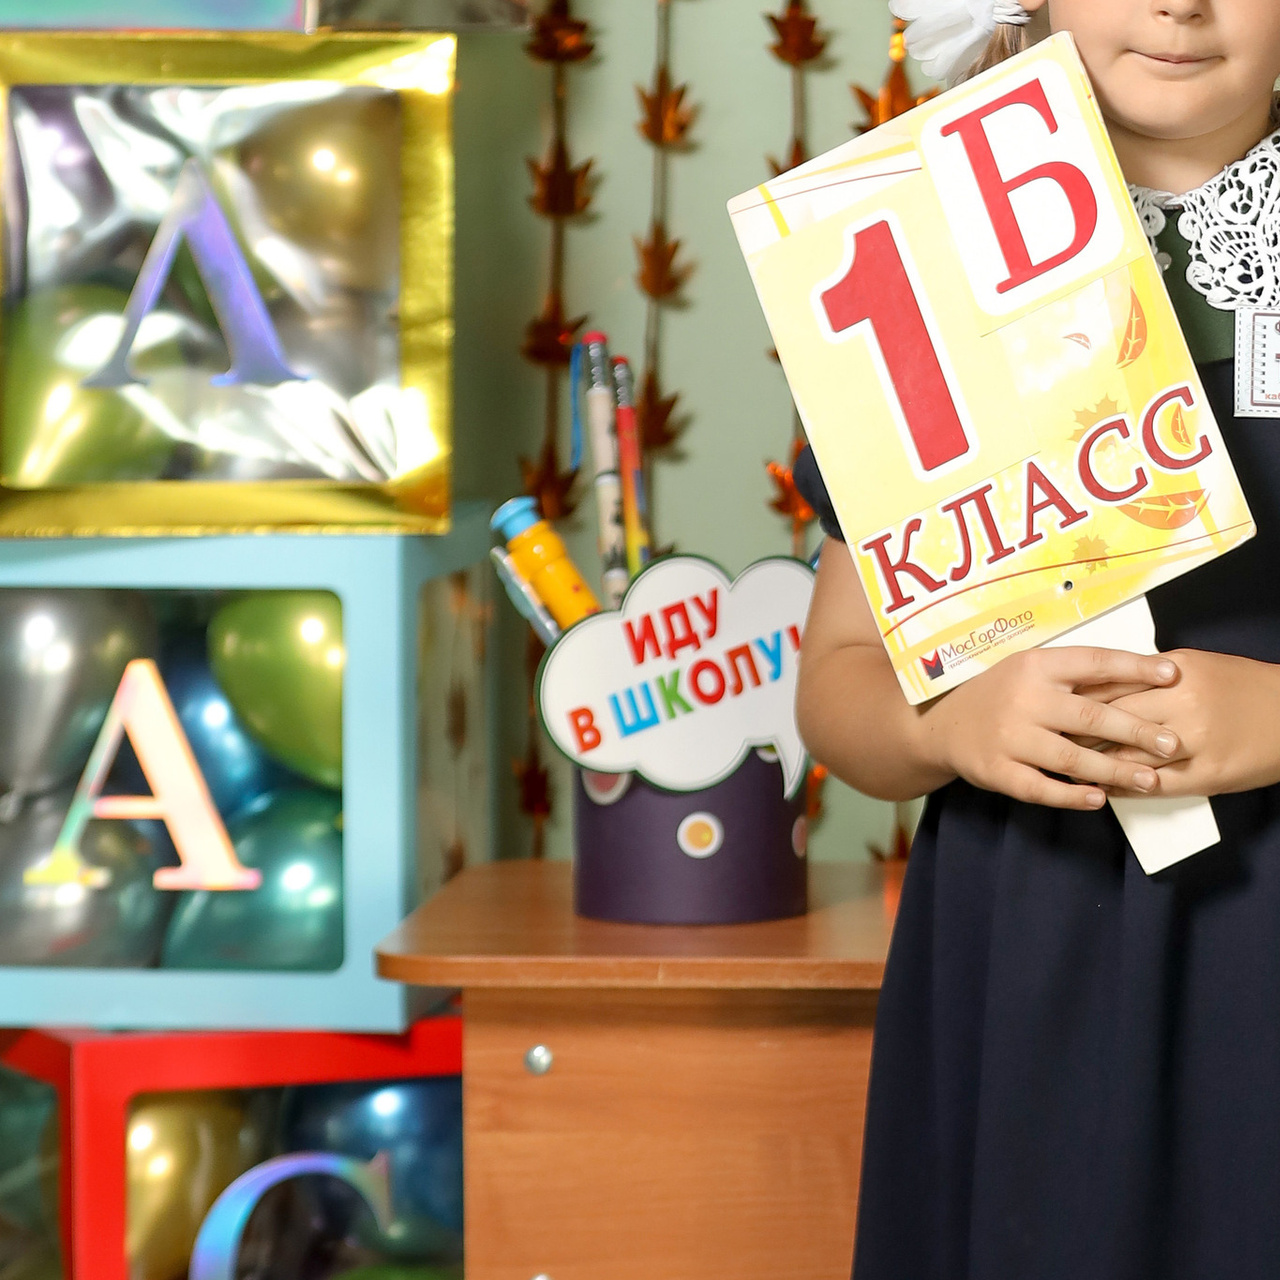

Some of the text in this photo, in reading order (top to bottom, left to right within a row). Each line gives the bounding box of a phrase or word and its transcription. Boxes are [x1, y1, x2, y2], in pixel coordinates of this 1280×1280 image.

[820, 76, 1099, 473] 1 Б
[861, 384, 1213, 615] КЛАСС
[622, 587, 719, 667] ИДУ
[940, 610, 1033, 662] МосГорФото
[567, 705, 603, 756] В
